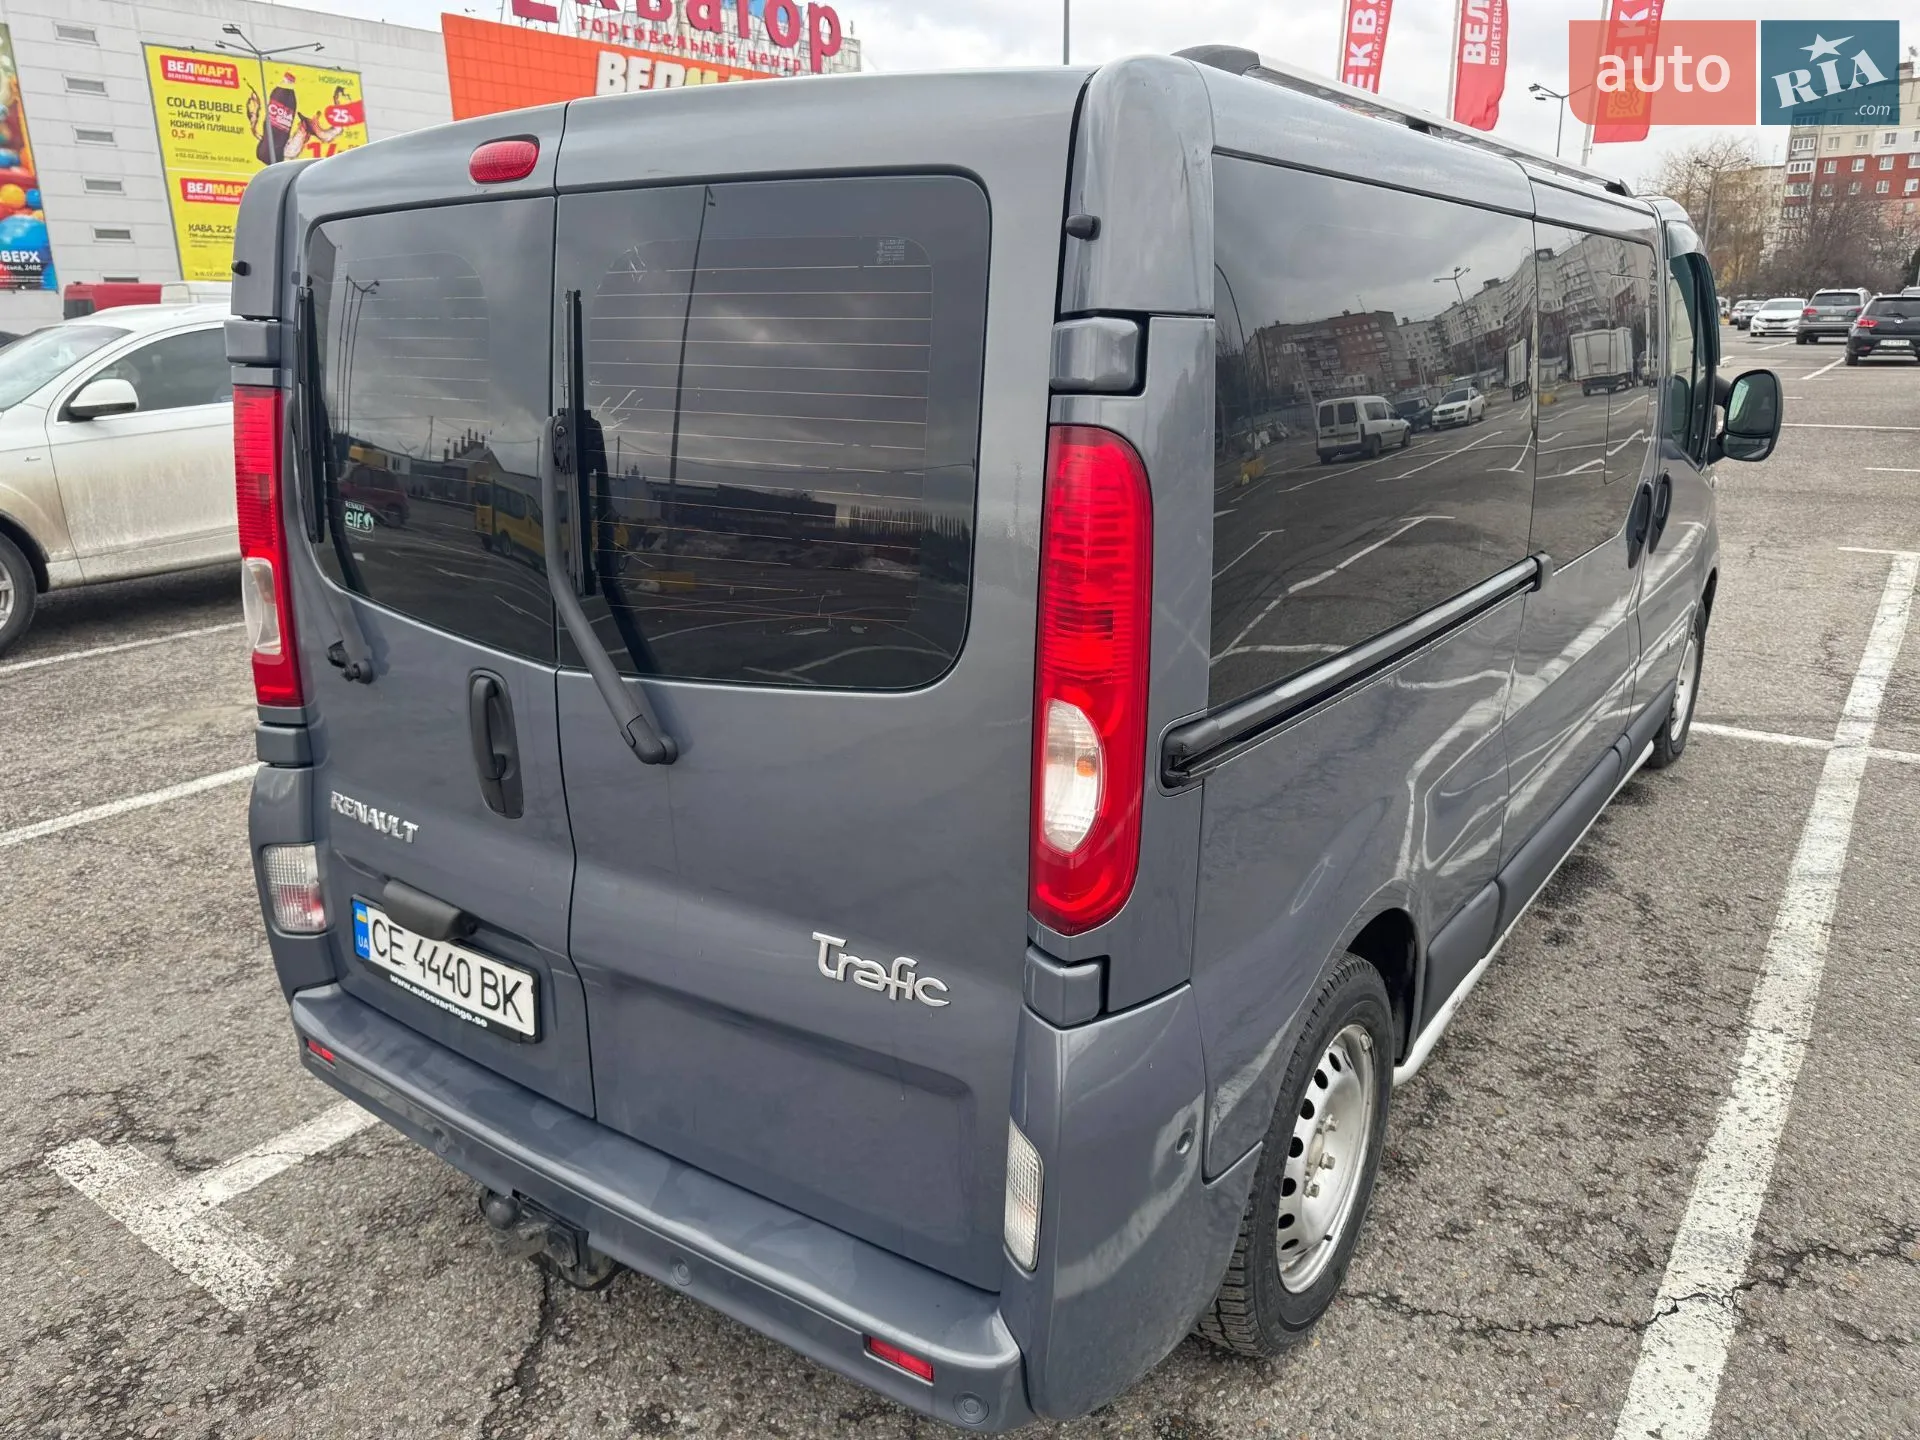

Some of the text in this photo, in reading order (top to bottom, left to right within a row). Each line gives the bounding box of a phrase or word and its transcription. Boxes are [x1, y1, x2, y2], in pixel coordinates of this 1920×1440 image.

[167, 59, 234, 79] ВЕЛМАРТ
[747, 49, 801, 75] центр
[166, 96, 244, 114] COLA BUBBLE
[331, 790, 419, 843] RENAULT
[358, 936, 369, 950] UA
[372, 918, 525, 1024] CE 4440 BK
[812, 931, 951, 1007] Trafic
